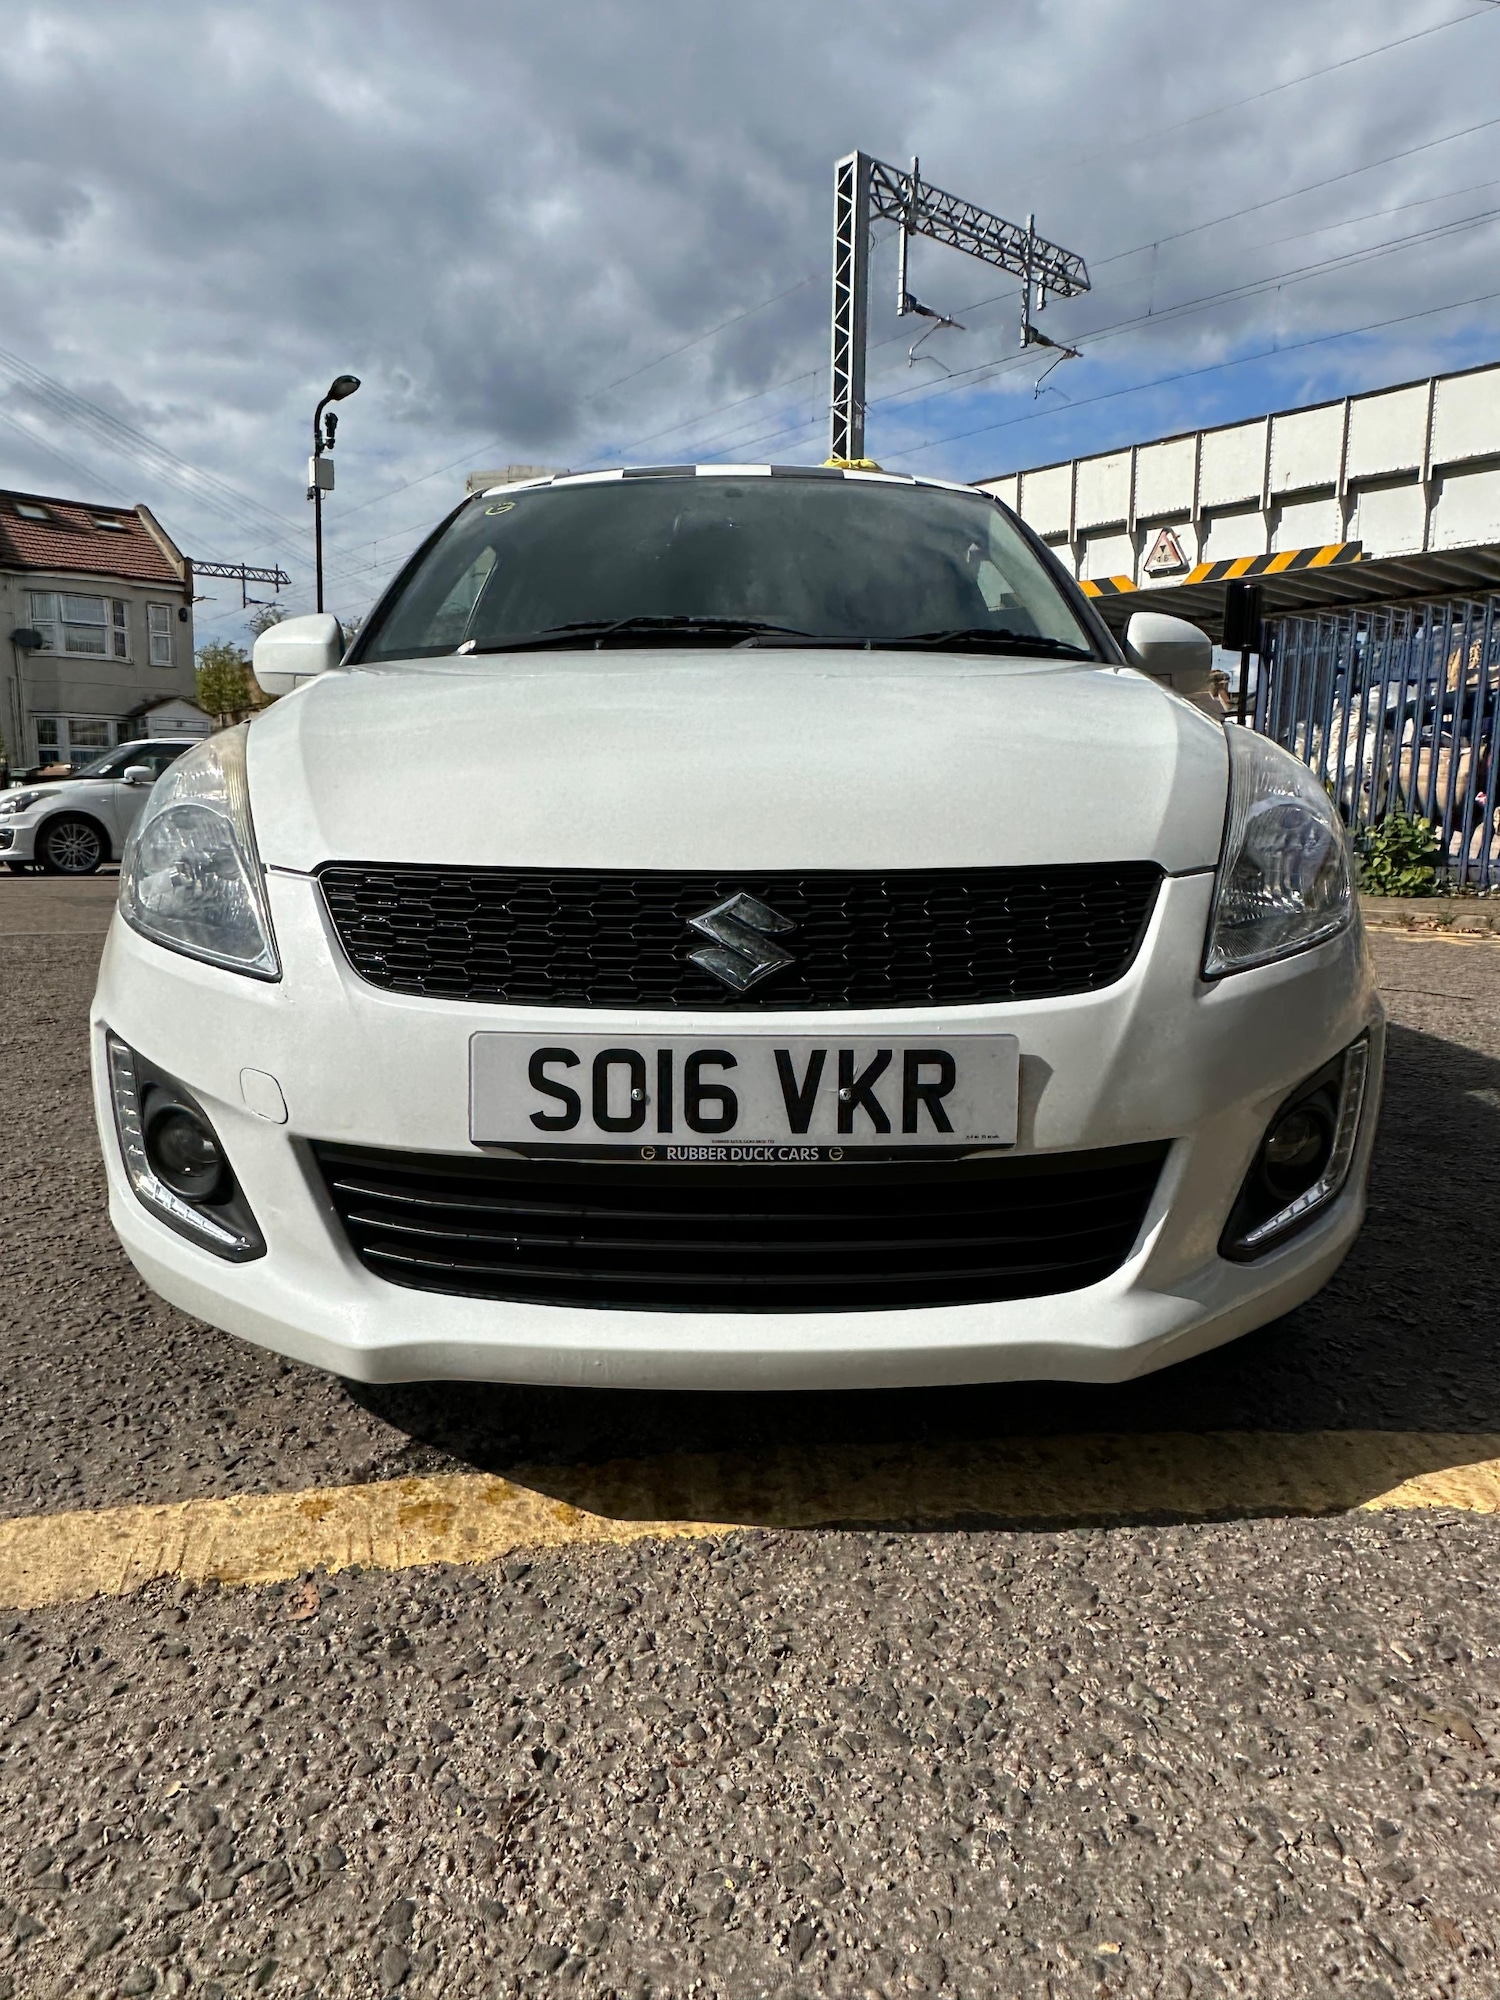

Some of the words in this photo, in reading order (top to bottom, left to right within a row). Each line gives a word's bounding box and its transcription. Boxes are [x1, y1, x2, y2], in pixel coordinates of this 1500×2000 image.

[528, 1047, 739, 1133] SO16
[773, 1048, 957, 1134] VKR
[666, 1146, 728, 1161] RUBBER
[730, 1147, 775, 1161] DUCK
[777, 1147, 820, 1161] CARS
